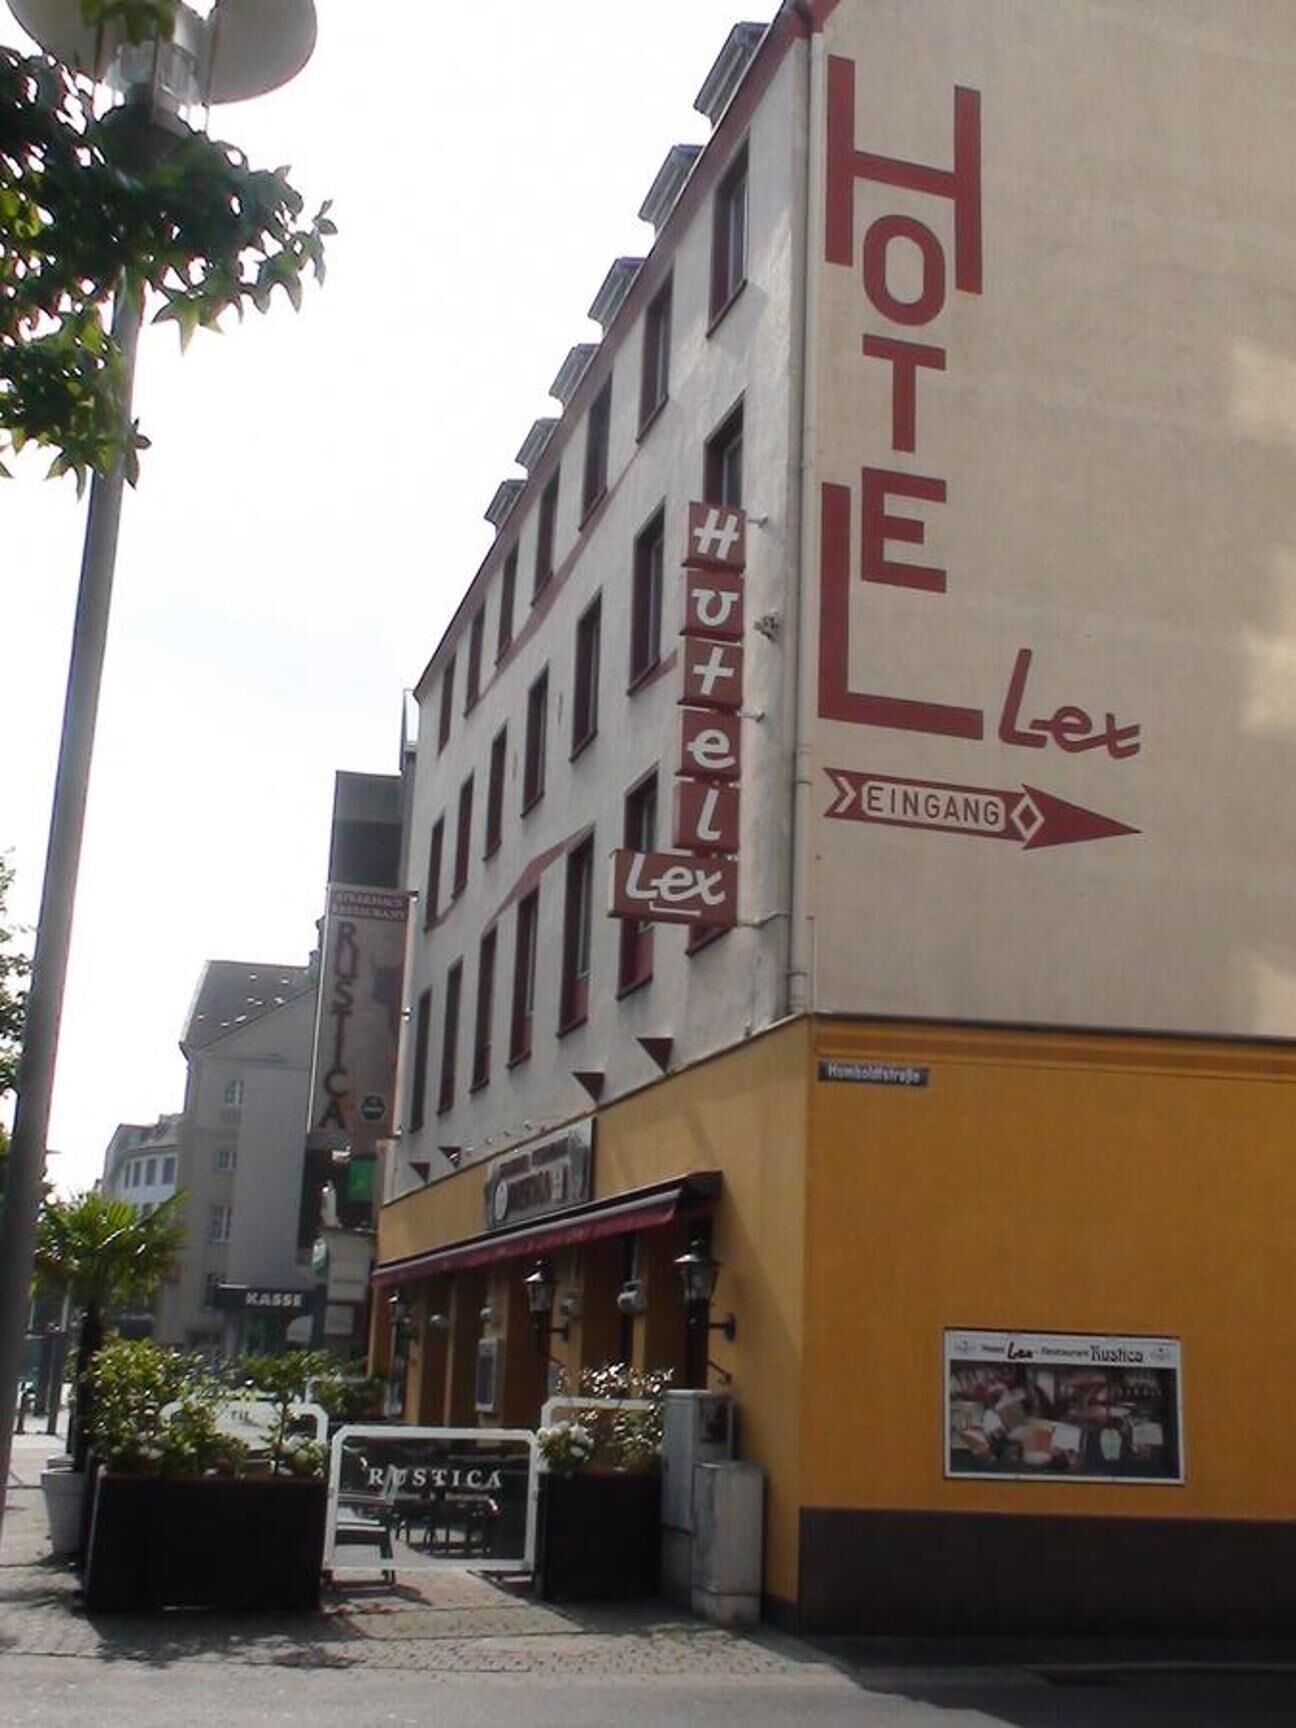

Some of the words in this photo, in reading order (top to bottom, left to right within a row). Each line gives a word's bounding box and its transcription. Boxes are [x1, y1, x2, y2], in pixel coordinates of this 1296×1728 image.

[818, 54, 983, 740] HOTEL
[998, 648, 1141, 759] Lex
[866, 786, 1000, 826] EINGANG
[626, 853, 725, 906] Lex
[246, 1292, 302, 1307] KASSE
[1090, 1346, 1143, 1363] Rustica
[368, 1467, 501, 1488] RUSTICA
